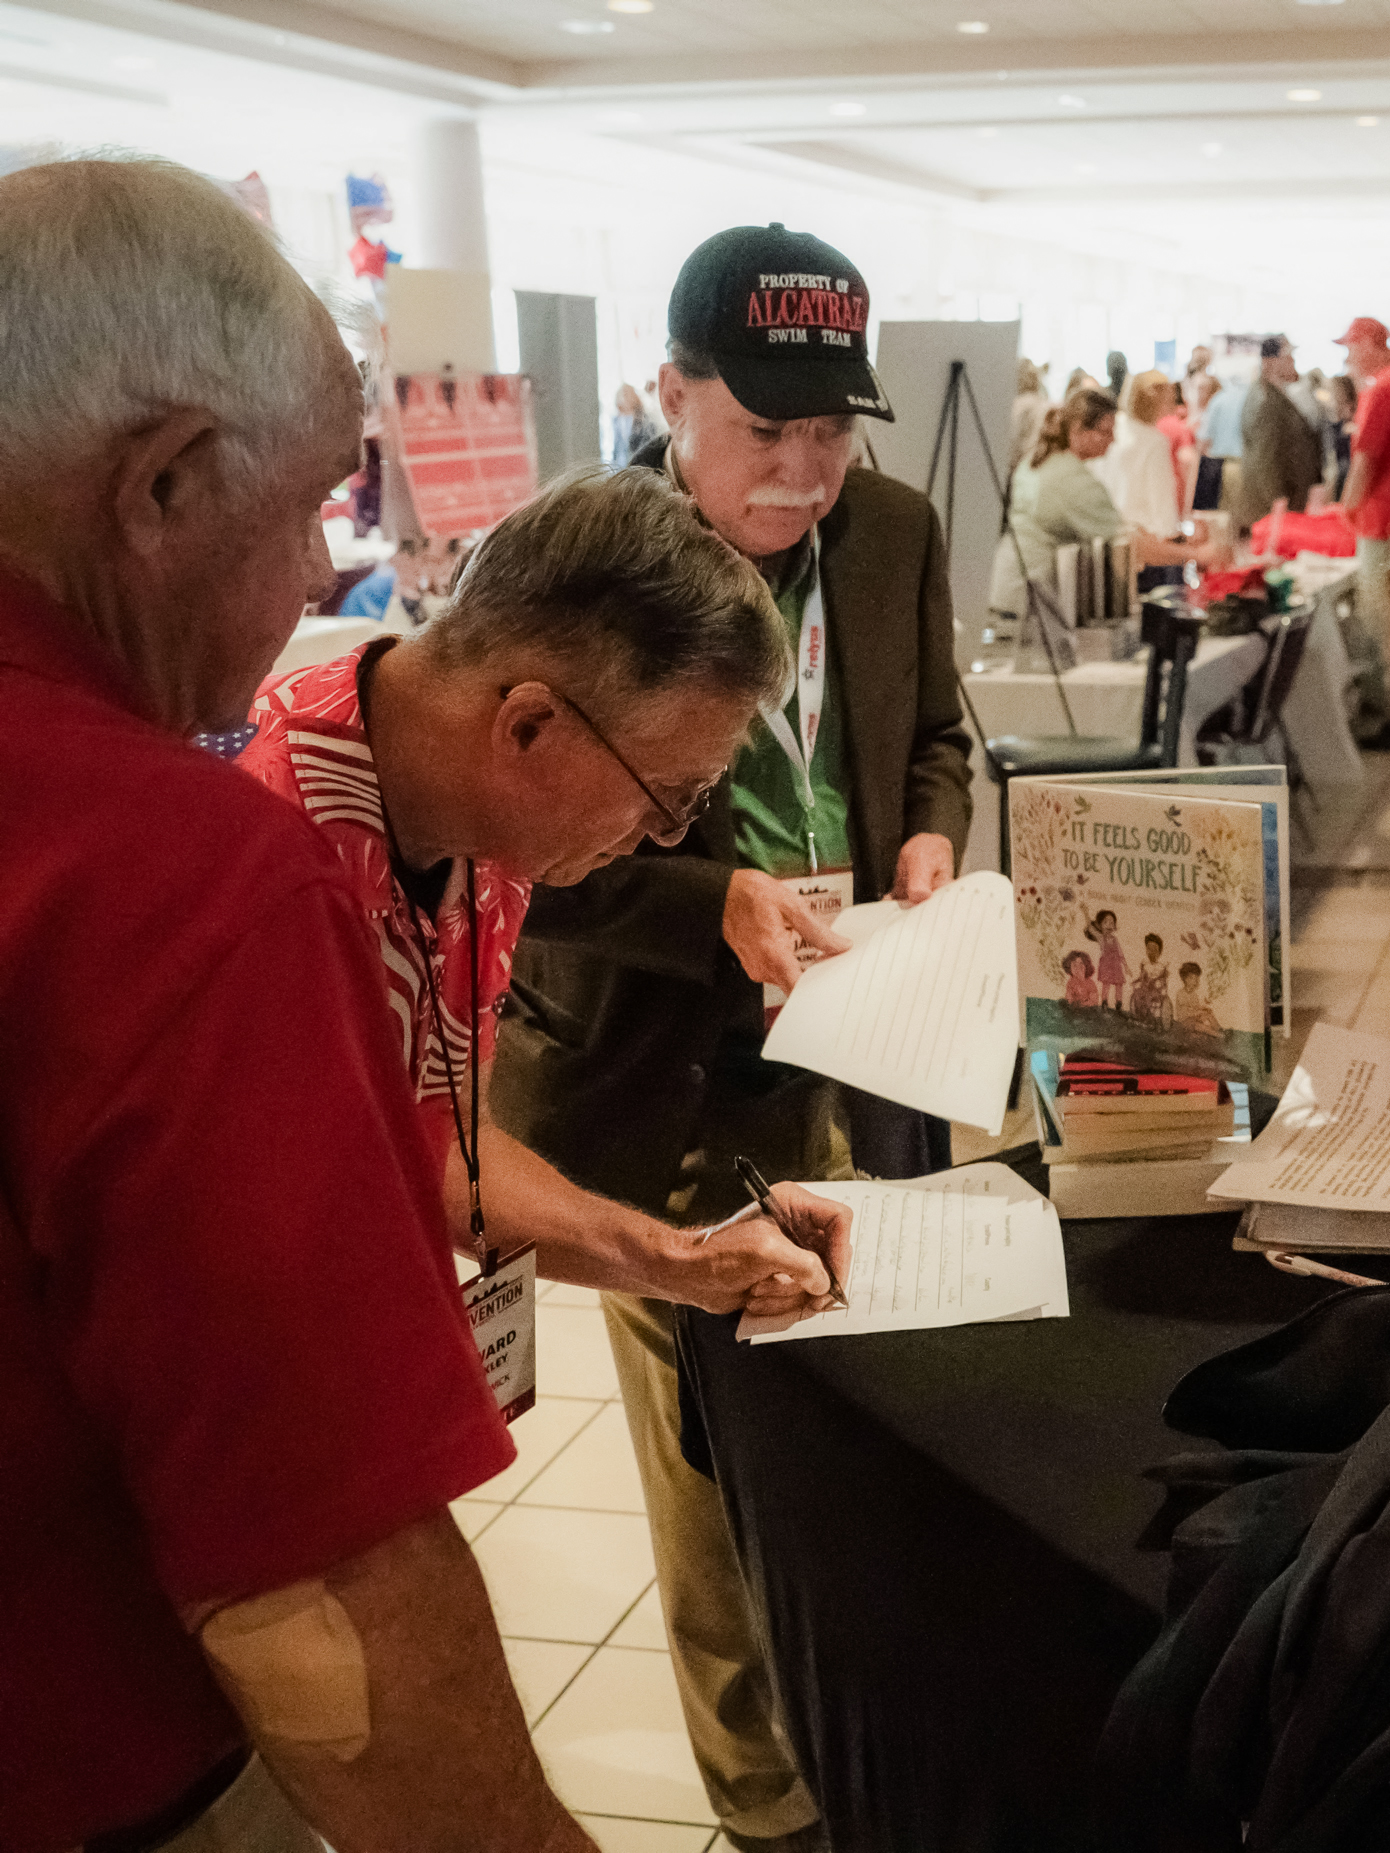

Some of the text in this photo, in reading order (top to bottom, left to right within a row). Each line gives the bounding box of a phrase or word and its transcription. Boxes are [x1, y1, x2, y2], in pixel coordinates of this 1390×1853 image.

[759, 273, 850, 293] PROPERTY OF
[747, 289, 863, 332] ALCATRAZ
[768, 328, 851, 346] SWIM TEAM
[1071, 822, 1192, 856] IT FEELS GOOD
[1061, 848, 1201, 893] TO BE YOURSELF
